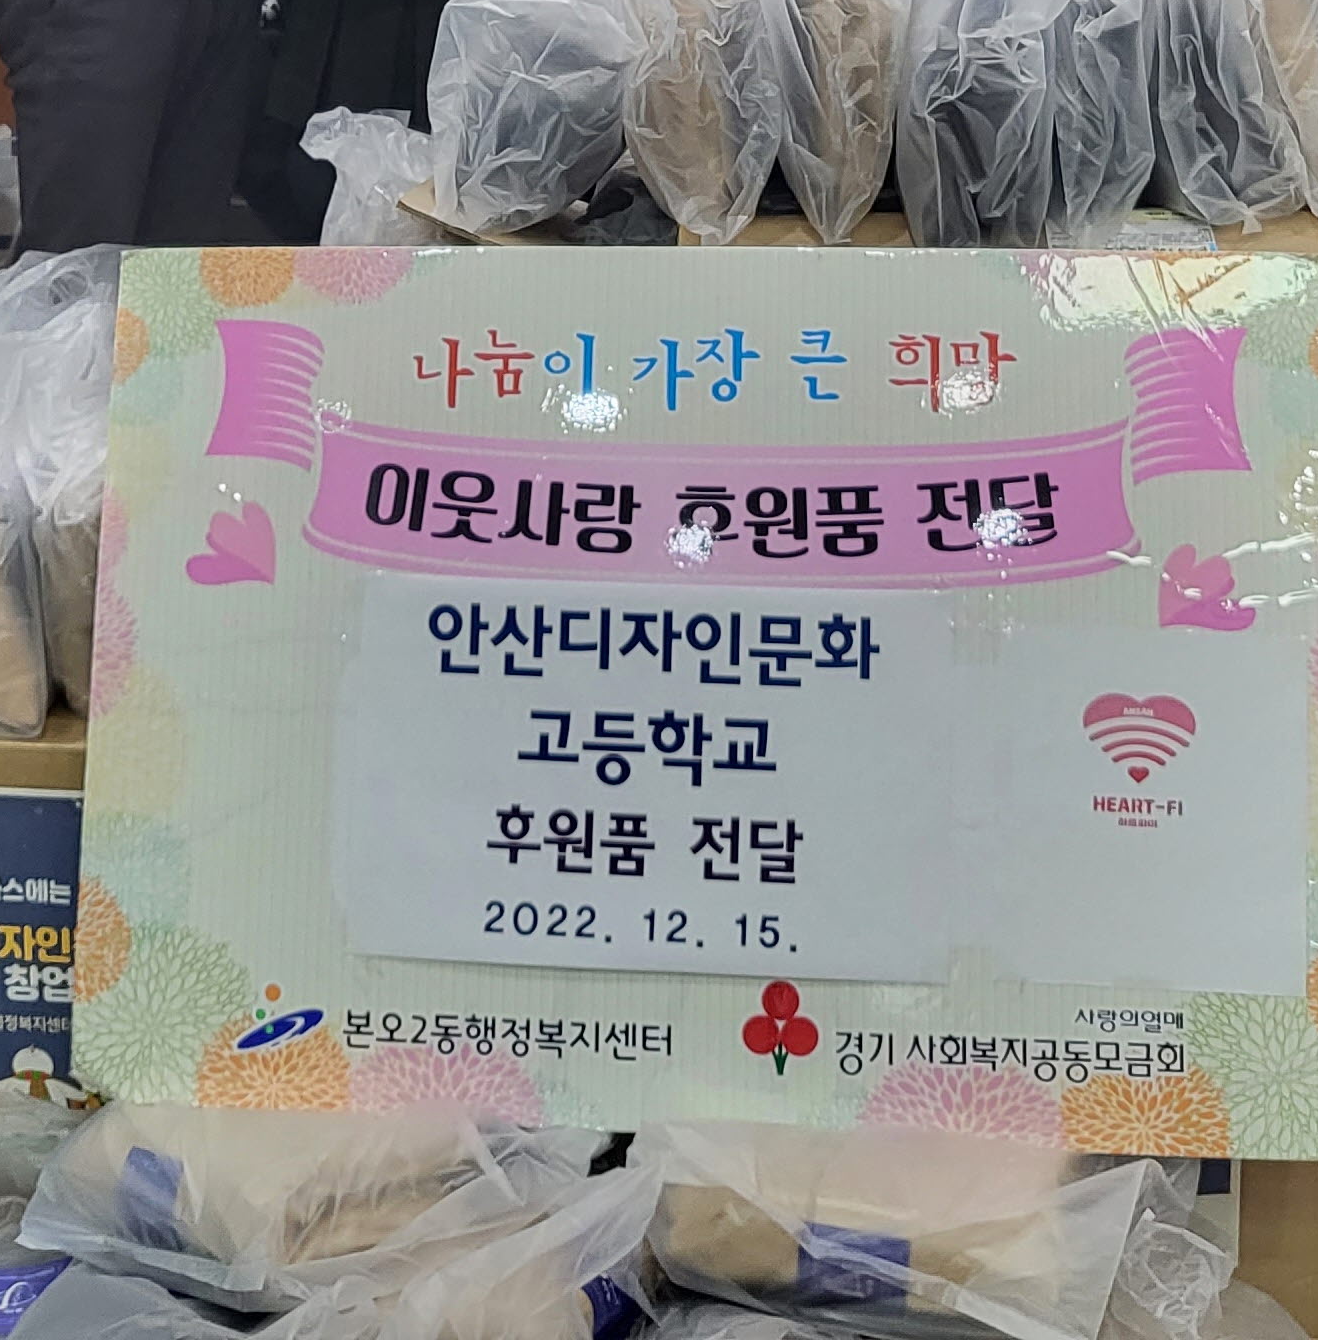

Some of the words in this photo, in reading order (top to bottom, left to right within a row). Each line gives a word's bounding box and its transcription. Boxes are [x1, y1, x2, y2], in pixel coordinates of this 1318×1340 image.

[413, 329, 596, 410] 나눔이
[633, 328, 762, 412] 가장
[790, 328, 847, 400] 큰
[365, 462, 642, 555] 이웃사랑
[916, 472, 1059, 552] 전달
[428, 603, 880, 687] 안산디자인문화
[517, 709, 777, 787] 고등학교
[1093, 795, 1183, 816] HEART-FI
[487, 803, 656, 877] 후원품
[690, 816, 804, 885] 전달
[483, 901, 613, 943] 2022.
[643, 908, 704, 948] 12.
[735, 914, 798, 953] 15.
[3, 963, 76, 1003] 창업
[343, 1009, 674, 1061] 본오2동행정복지센터
[1074, 1008, 1185, 1034] 사랑의열매
[835, 1031, 894, 1077] 경기
[906, 1033, 1186, 1084] 사회복지공동모금회
